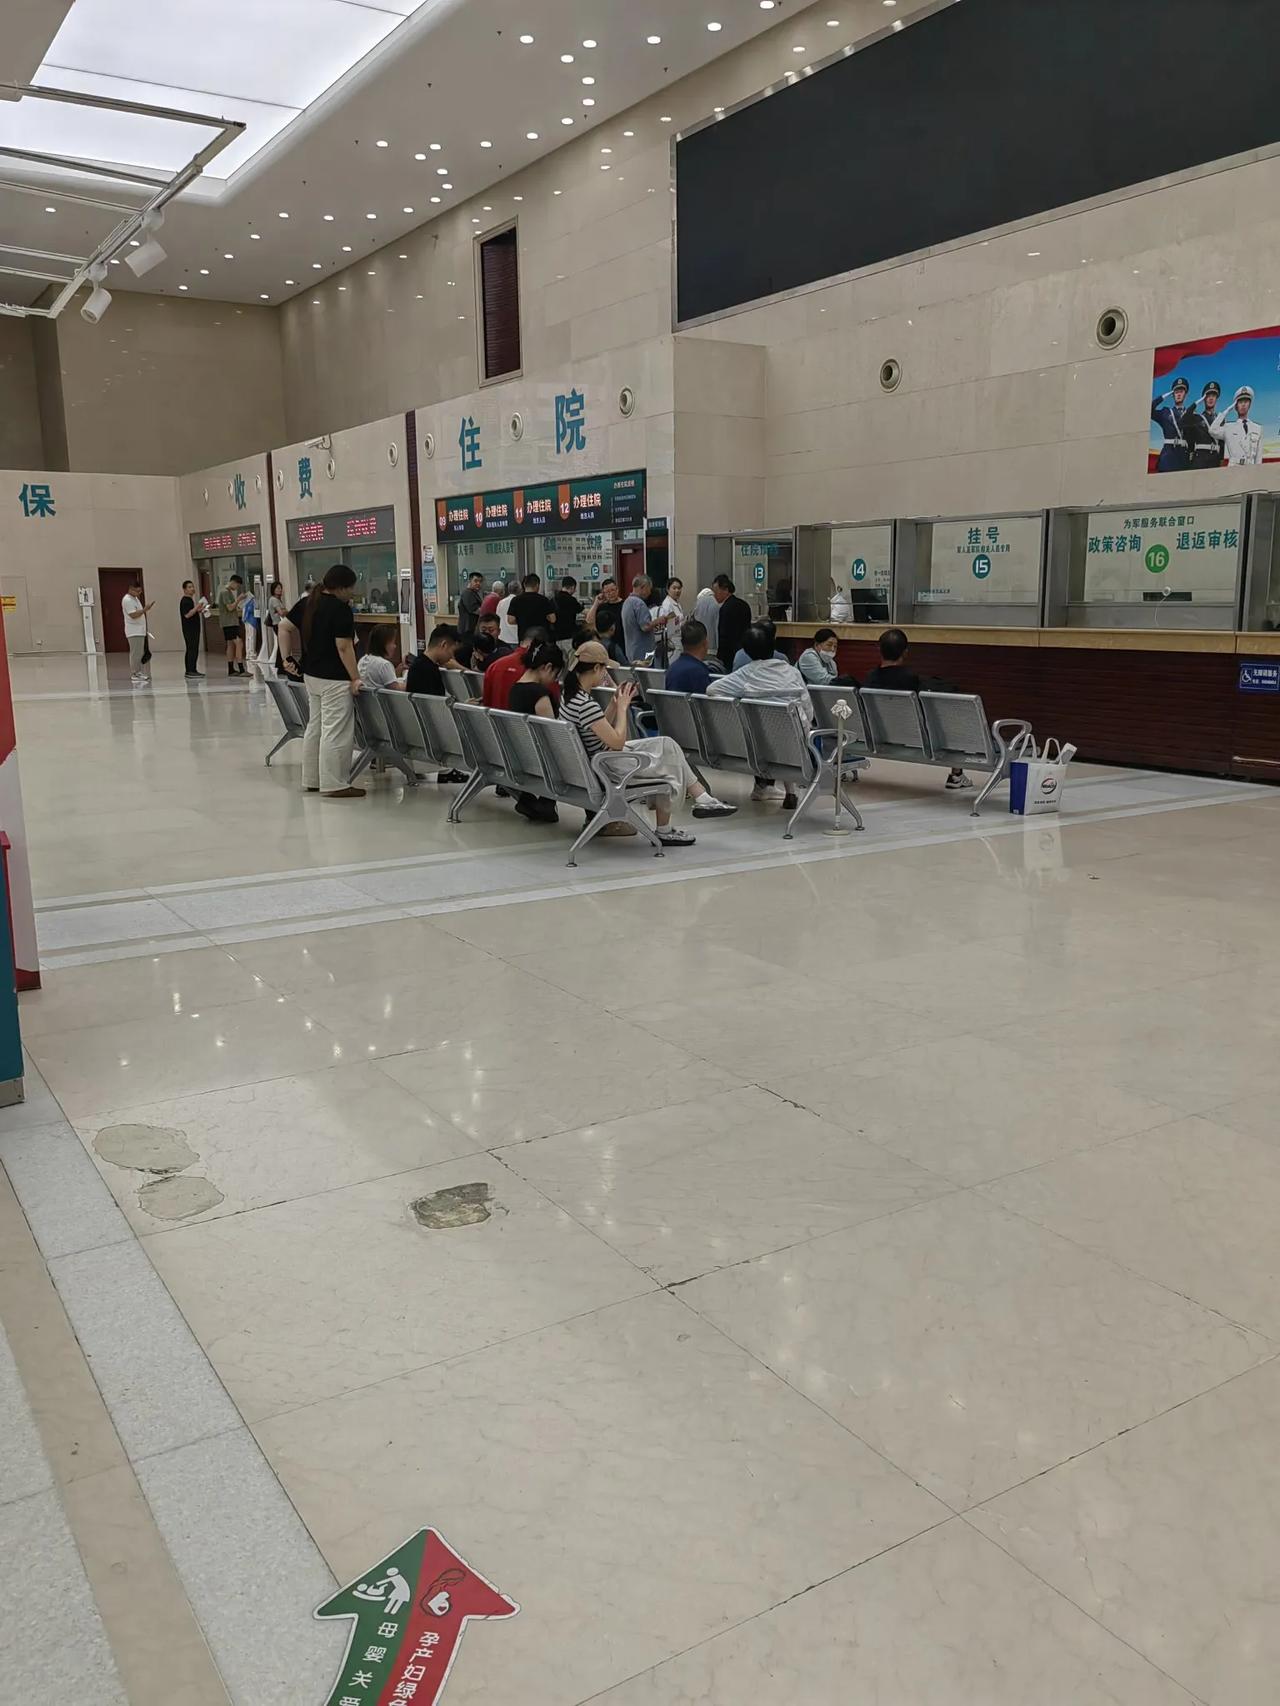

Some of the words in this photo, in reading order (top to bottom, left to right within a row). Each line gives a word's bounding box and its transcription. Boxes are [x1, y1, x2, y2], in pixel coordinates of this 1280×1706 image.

[18, 482, 57, 518] 保
[526, 499, 552, 514] 办理住院
[573, 493, 601, 509] 办理住院
[448, 508, 469, 522] 办理住院
[485, 504, 508, 518] 办理住院
[515, 507, 523, 518] 11
[560, 502, 570, 514] 12
[475, 512, 483, 523] 10
[1124, 516, 1194, 529] 为军服务联合窗口
[968, 527, 1000, 545] 挂号
[1176, 529, 1239, 550] 退返审核
[1088, 535, 1141, 553] 政策咨询
[1148, 551, 1165, 567] 16
[754, 567, 764, 579] 13
[853, 563, 866, 576] 14
[975, 559, 989, 574] 15
